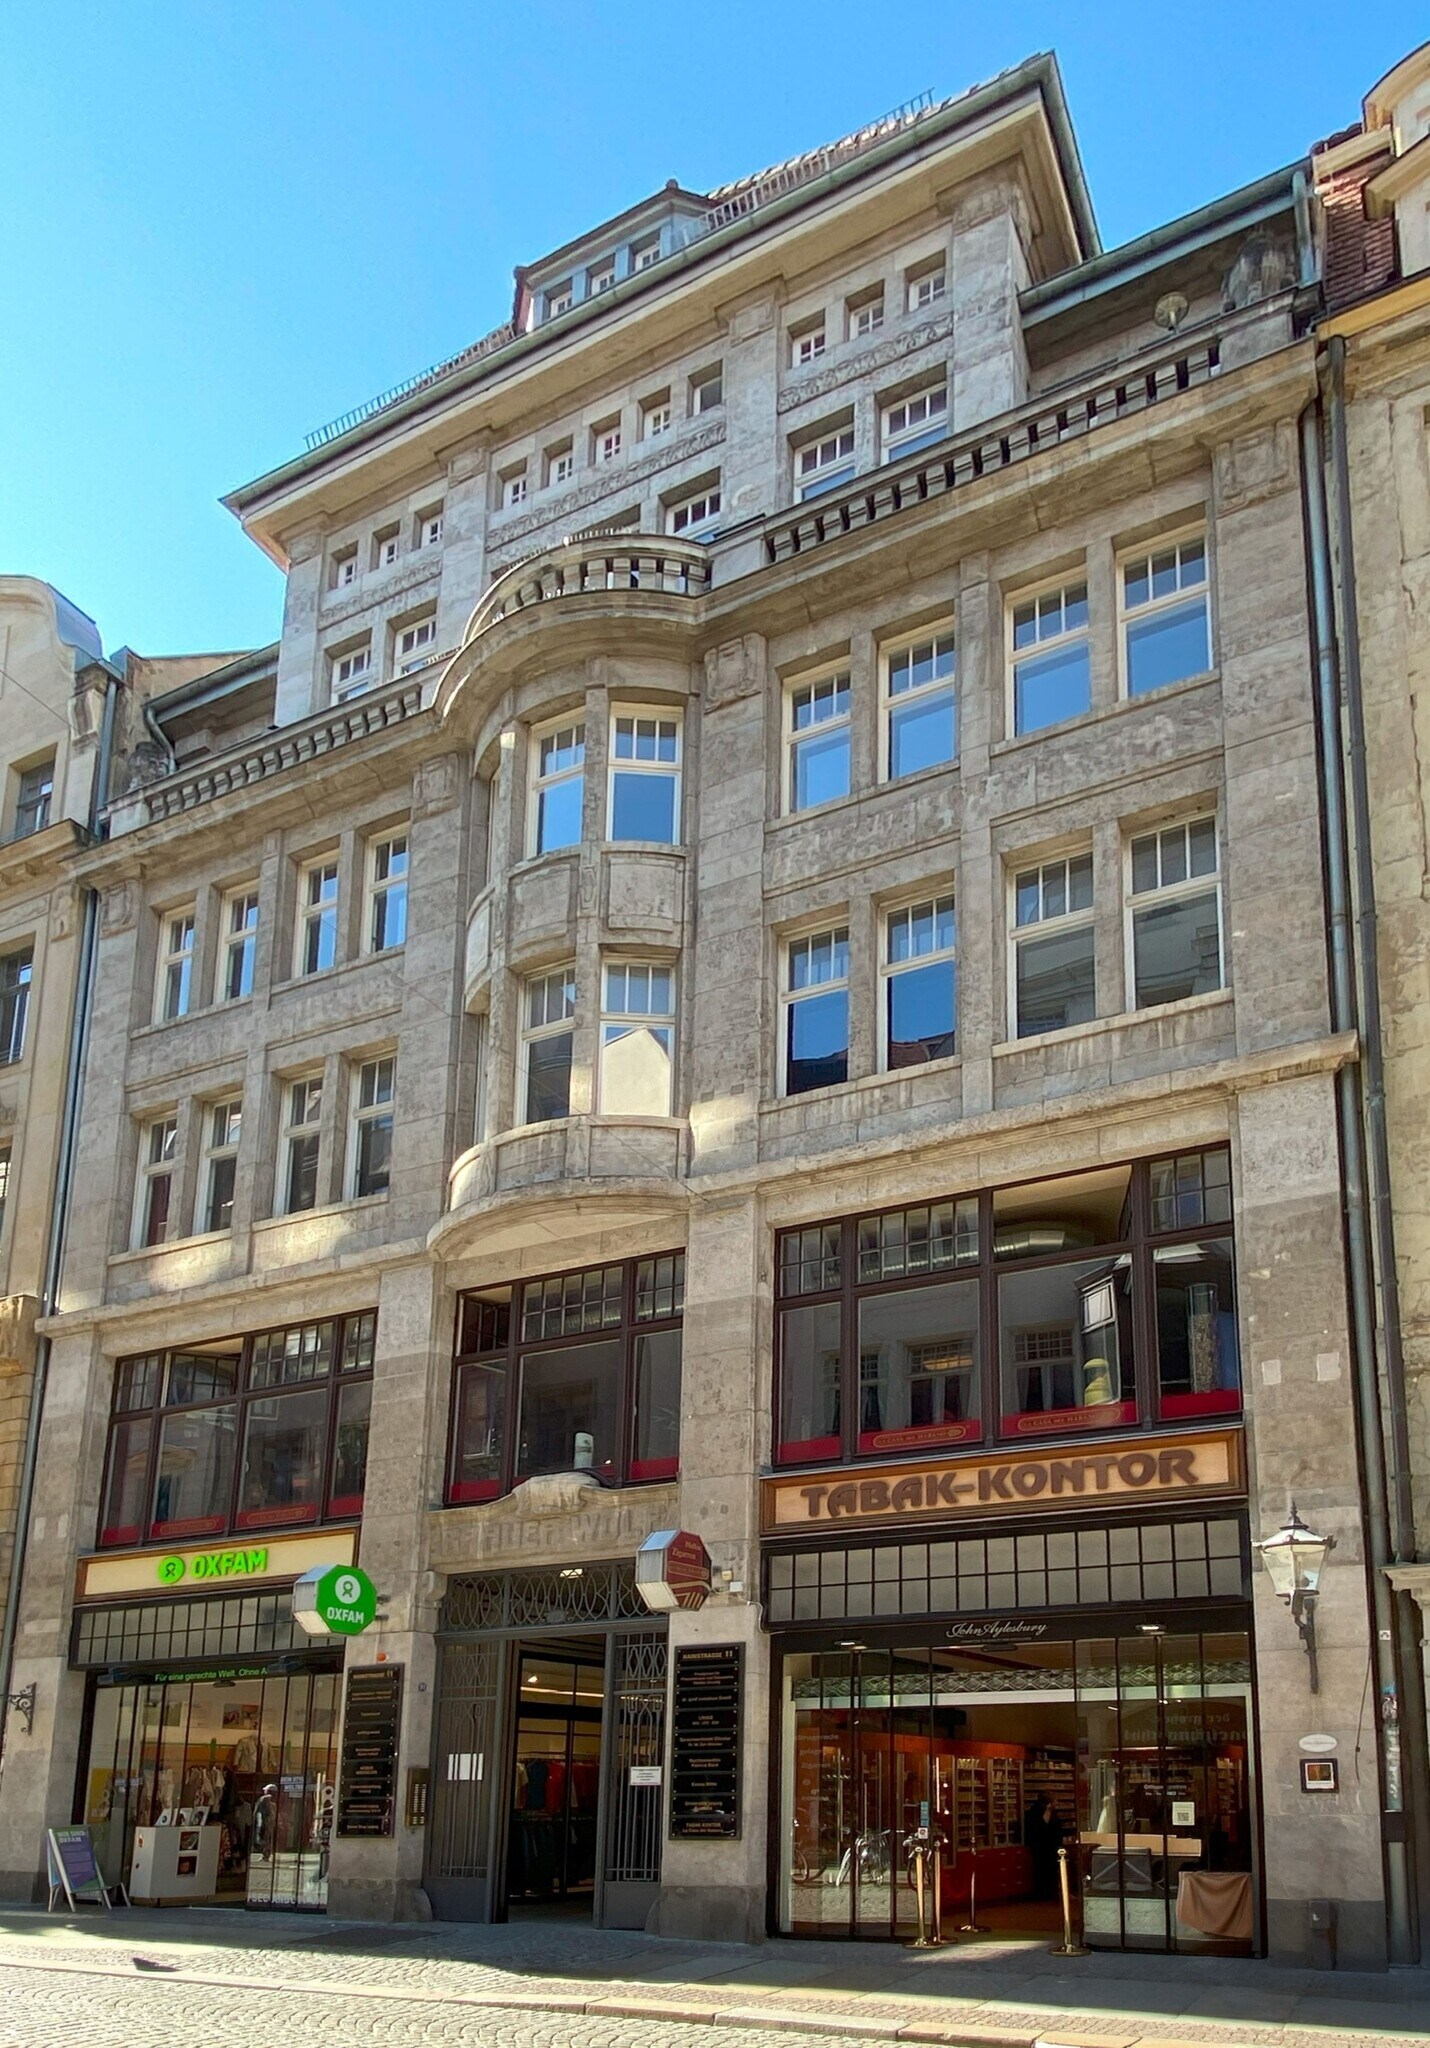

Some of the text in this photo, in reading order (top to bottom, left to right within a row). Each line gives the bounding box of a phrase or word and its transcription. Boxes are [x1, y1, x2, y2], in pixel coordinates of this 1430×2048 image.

[800, 1449, 1199, 1518] TABAK-KONTOR
[192, 1550, 268, 1578] OXFAM
[327, 1606, 364, 1624] OXFAM
[946, 1620, 1048, 1638] John Aylesbury
[155, 1673, 167, 1681] Für
[168, 1673, 184, 1681] eine
[185, 1671, 217, 1682] gerechte
[238, 1667, 259, 1677] Ohne
